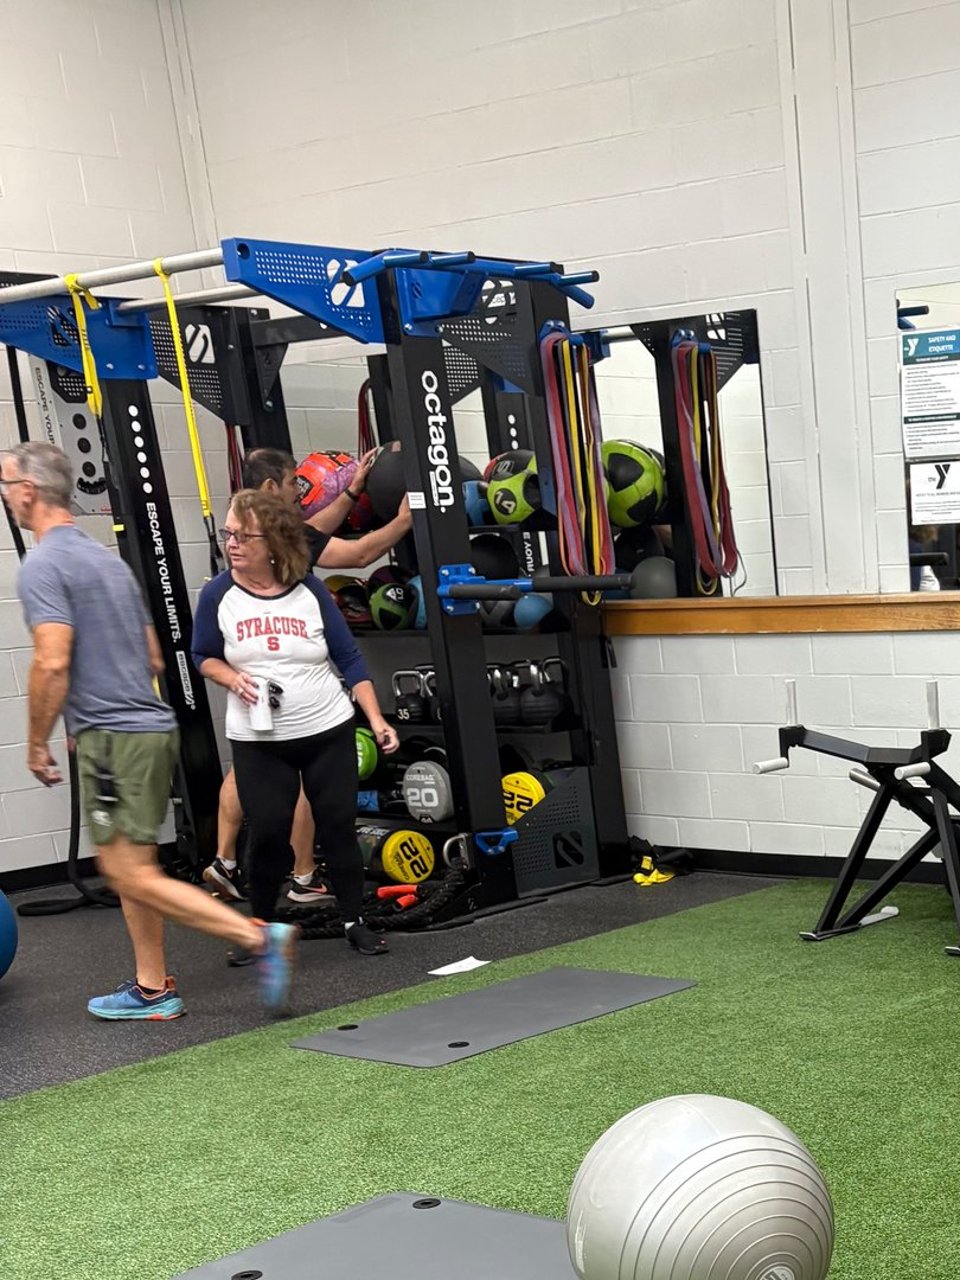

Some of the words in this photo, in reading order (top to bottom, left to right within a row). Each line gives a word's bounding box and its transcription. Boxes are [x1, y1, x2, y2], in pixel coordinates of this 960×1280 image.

[146, 502, 165, 556] ESCAPE
[157, 558, 172, 595] YOUR
[164, 597, 182, 643] LIMITS.
[236, 616, 308, 642] SYRACUSE
[267, 636, 280, 651] S
[398, 708, 410, 720] 35
[407, 787, 439, 807] 20
